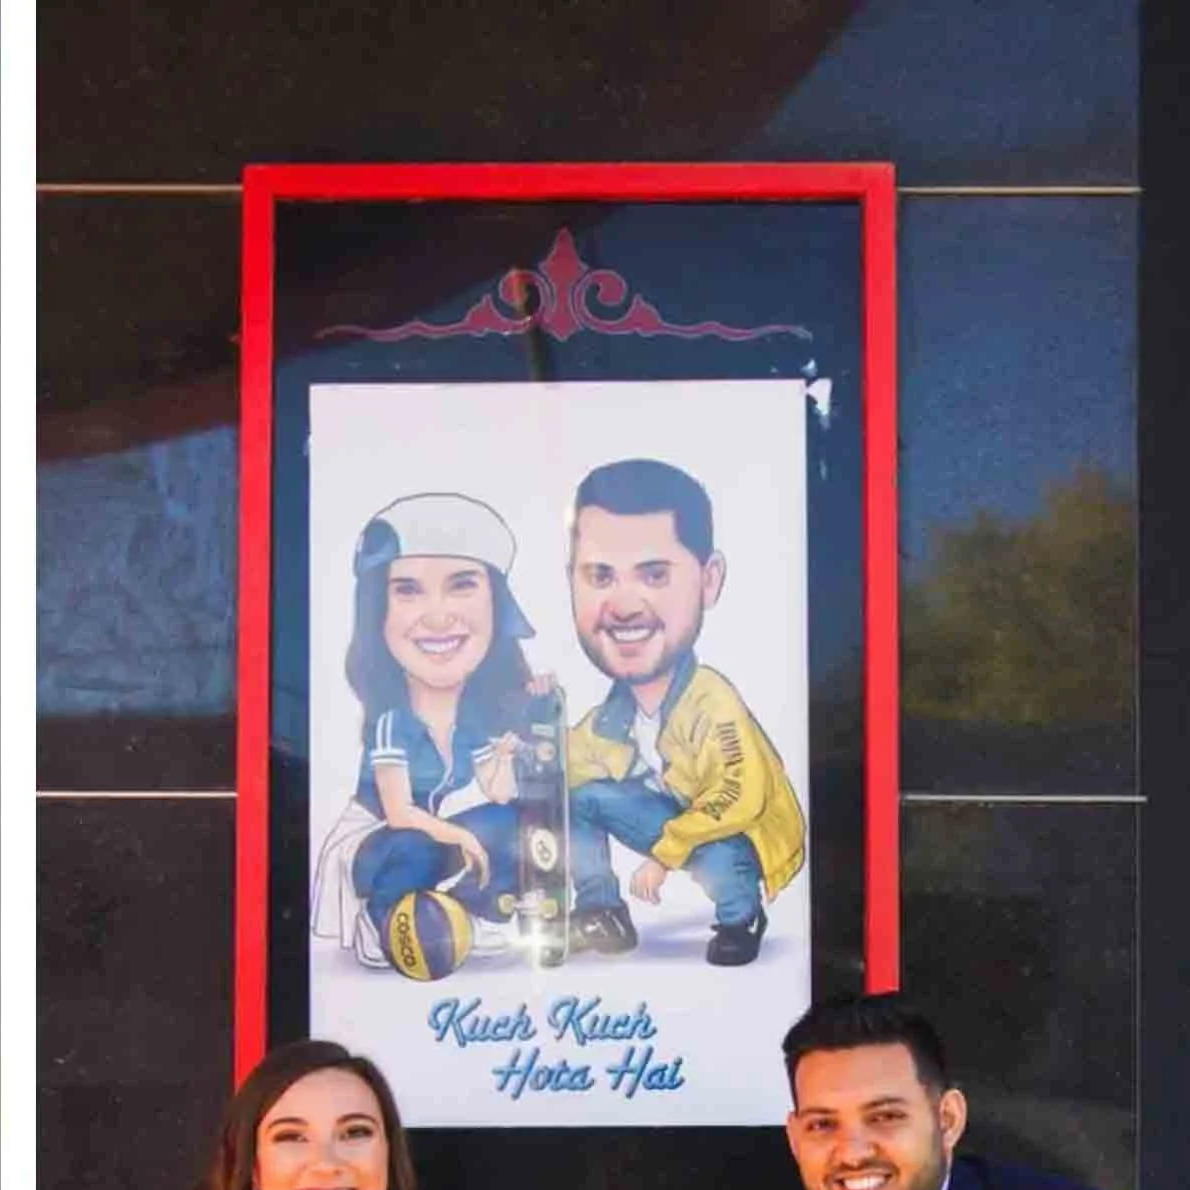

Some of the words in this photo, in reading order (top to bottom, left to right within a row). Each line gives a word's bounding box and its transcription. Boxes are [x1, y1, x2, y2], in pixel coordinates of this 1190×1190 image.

[396, 911, 418, 969] COSCO
[427, 996, 537, 1049] Kuch
[547, 995, 658, 1047] Kuch
[491, 1046, 596, 1101] Hota
[605, 1045, 686, 1100] Hai
